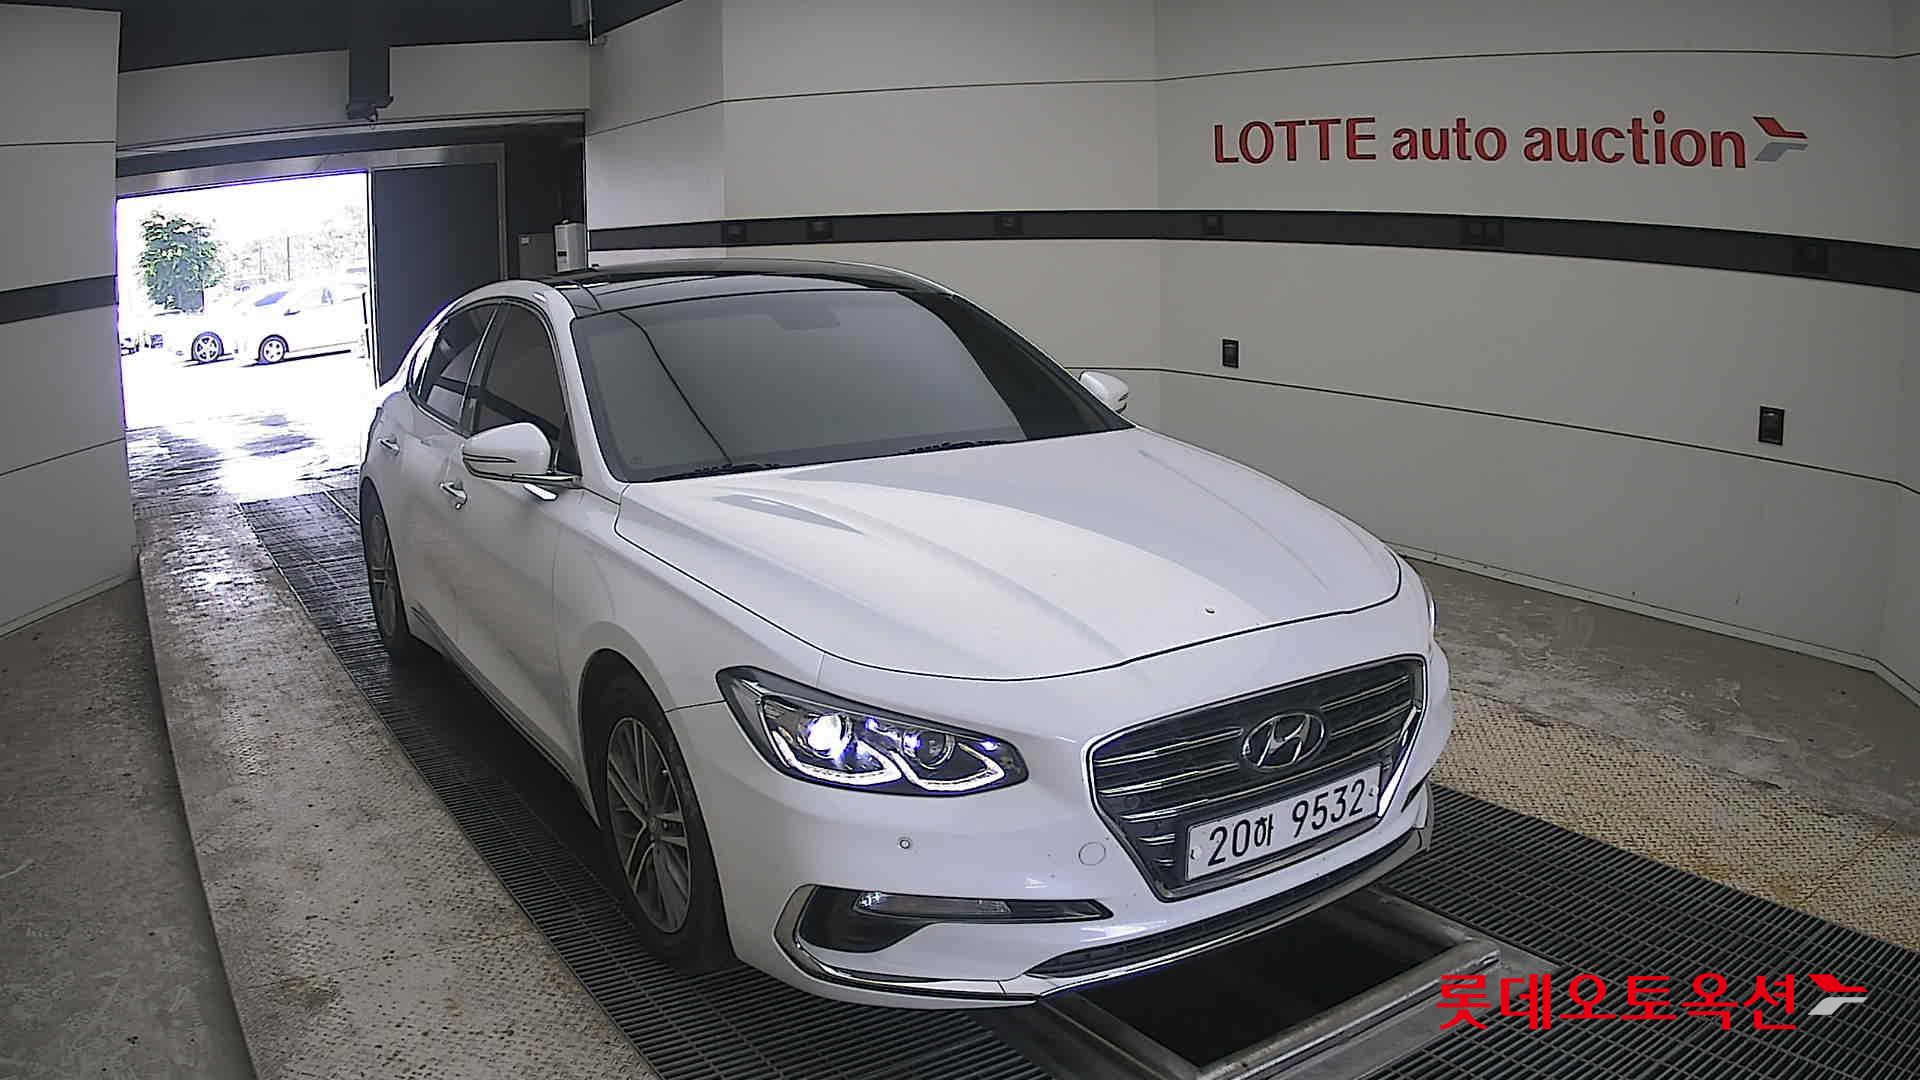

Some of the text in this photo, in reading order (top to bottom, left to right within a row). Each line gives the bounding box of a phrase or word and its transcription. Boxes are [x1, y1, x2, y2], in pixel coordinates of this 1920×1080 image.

[1213, 109, 1747, 169] LOTTE auto auction
[1207, 778, 1365, 867] 20하 9532
